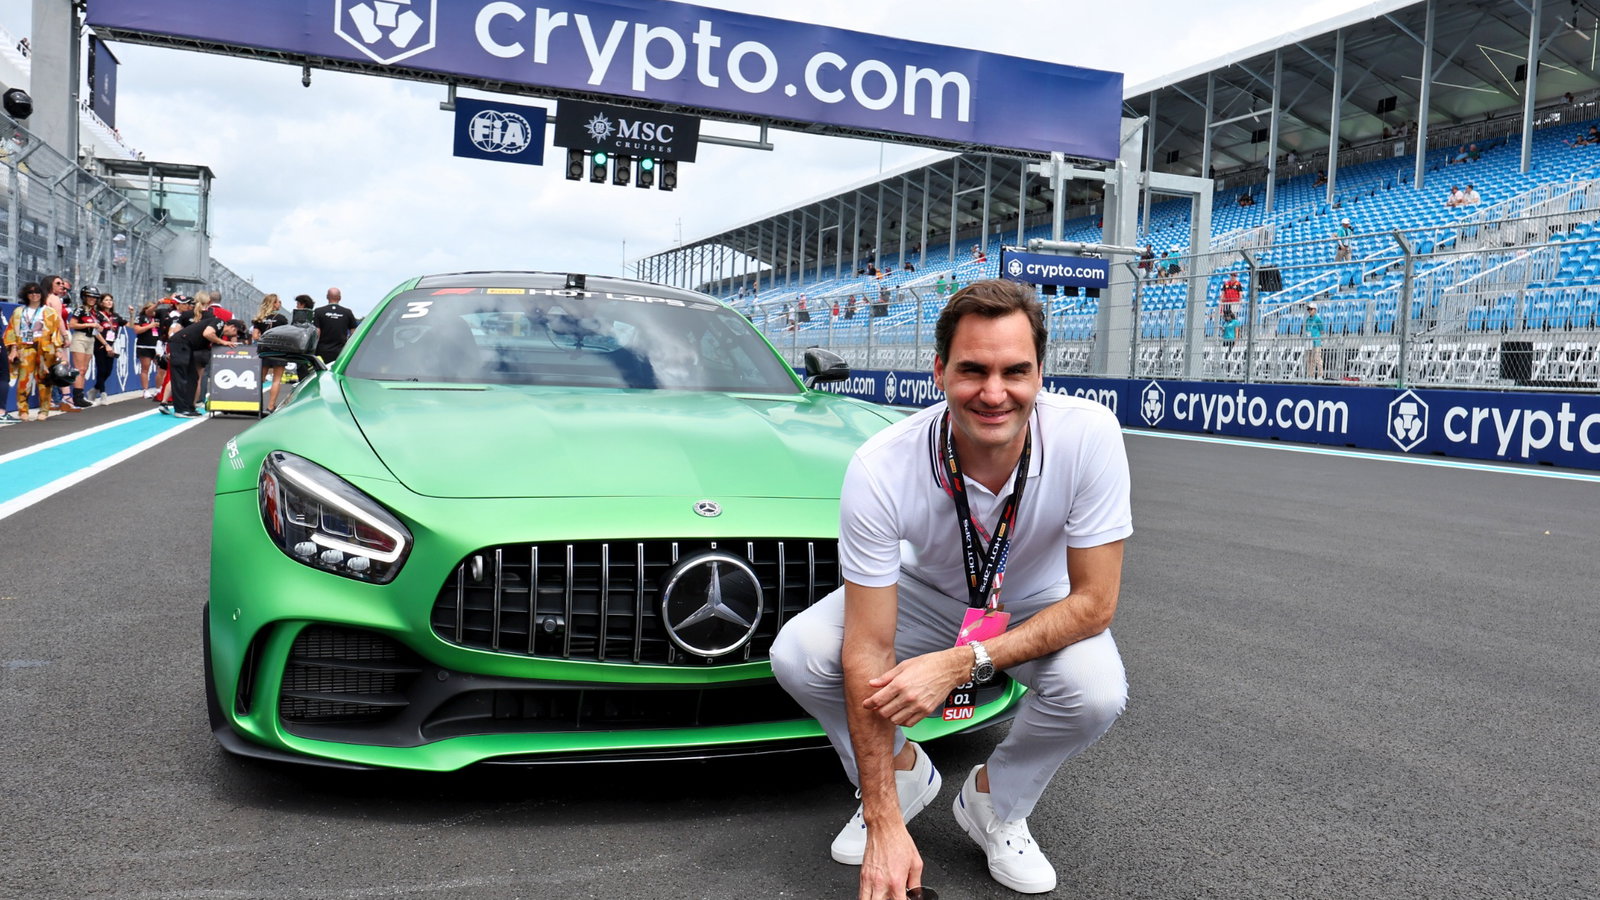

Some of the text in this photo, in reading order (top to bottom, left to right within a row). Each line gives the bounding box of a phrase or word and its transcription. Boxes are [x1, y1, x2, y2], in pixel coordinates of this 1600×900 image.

[475, 1, 971, 123] crypto.com
[616, 118, 675, 144] MSC
[615, 140, 672, 153] CRUISES
[1026, 263, 1105, 280] crypto.com
[401, 301, 433, 319] 3
[214, 368, 257, 390] 04
[1173, 388, 1349, 434] crypto.com
[1443, 401, 1600, 458] crypto
[990, 537, 1002, 563] HOT
[954, 693, 971, 706] 01
[944, 707, 974, 720] SUN
